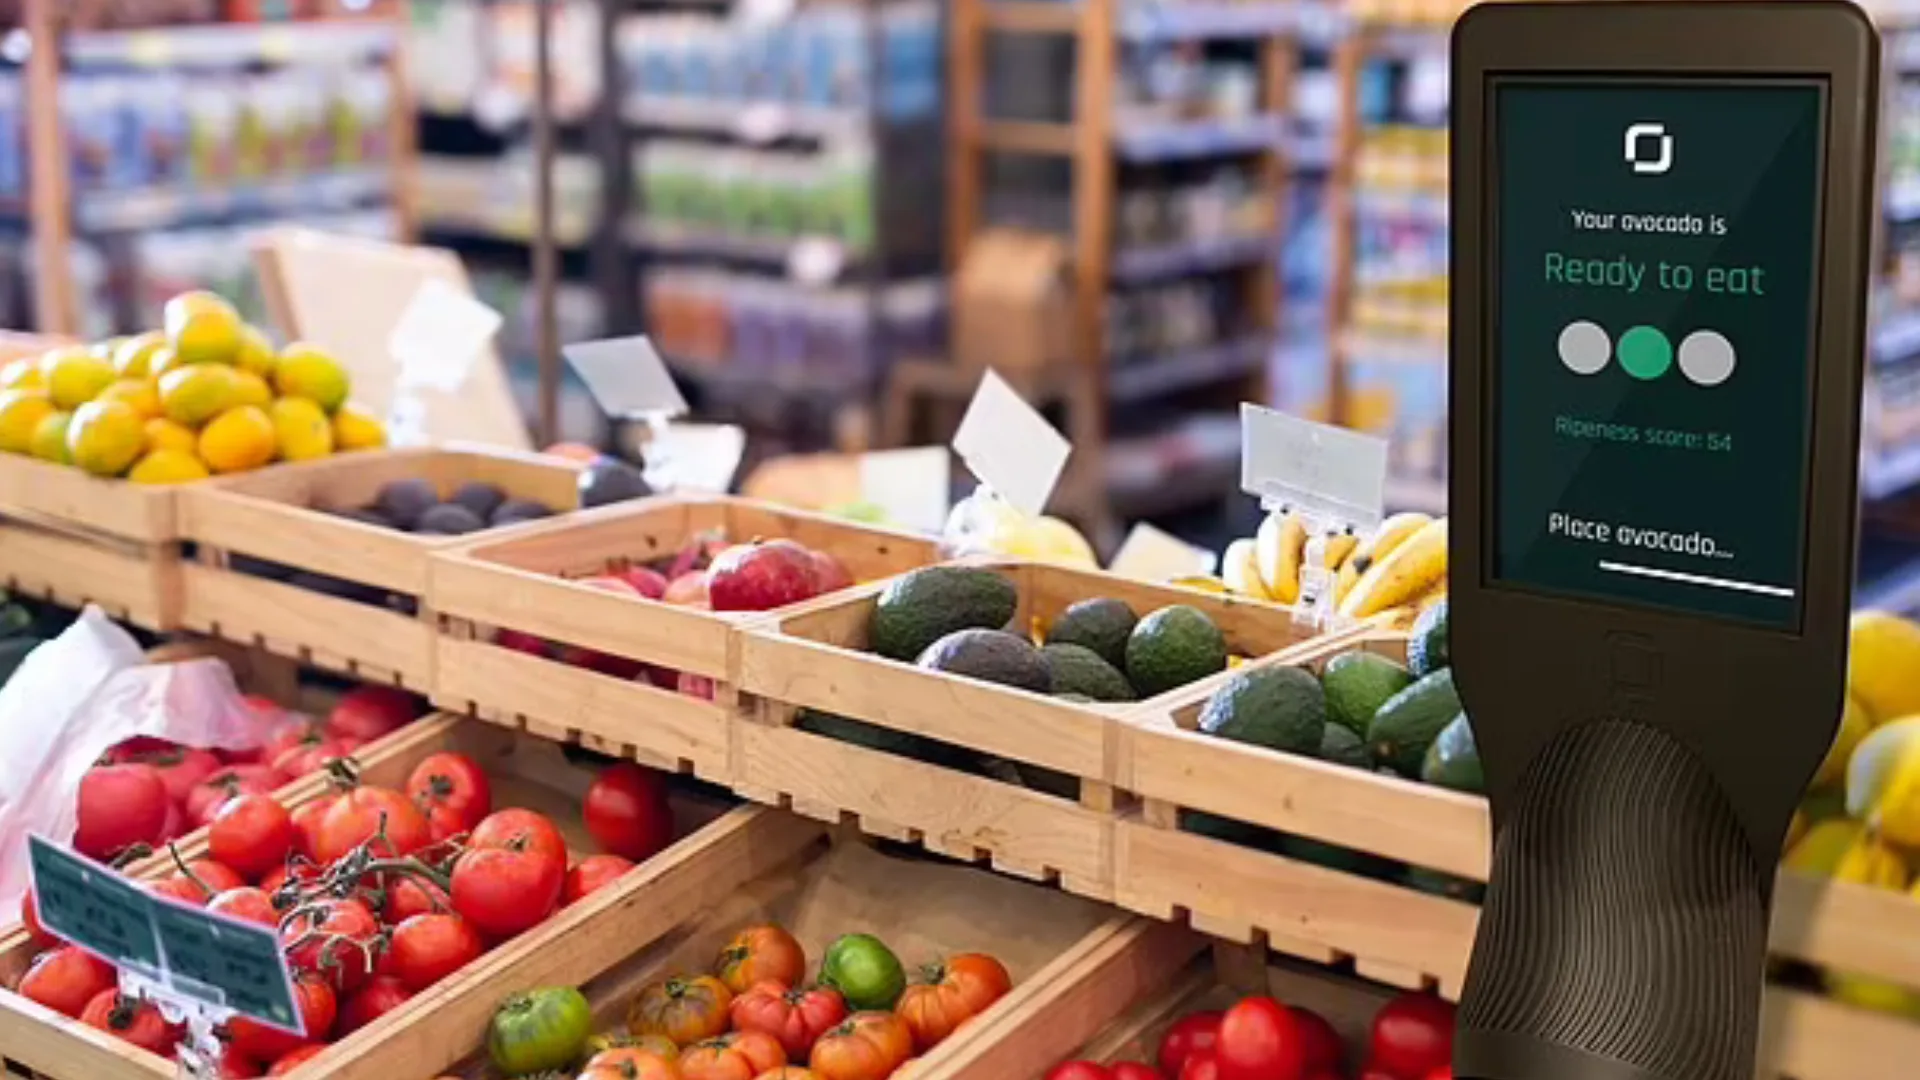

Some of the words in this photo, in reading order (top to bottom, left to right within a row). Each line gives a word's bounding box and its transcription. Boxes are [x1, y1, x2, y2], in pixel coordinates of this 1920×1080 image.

[1571, 210, 1616, 229] Your
[1621, 214, 1703, 235] avocado
[1710, 214, 1728, 236] is
[1545, 252, 1646, 293] Ready
[1659, 261, 1693, 291] to
[1706, 266, 1765, 296] eat
[1555, 415, 1640, 443] Ripeness
[1644, 427, 1703, 449] score:
[1549, 512, 1611, 542] Place
